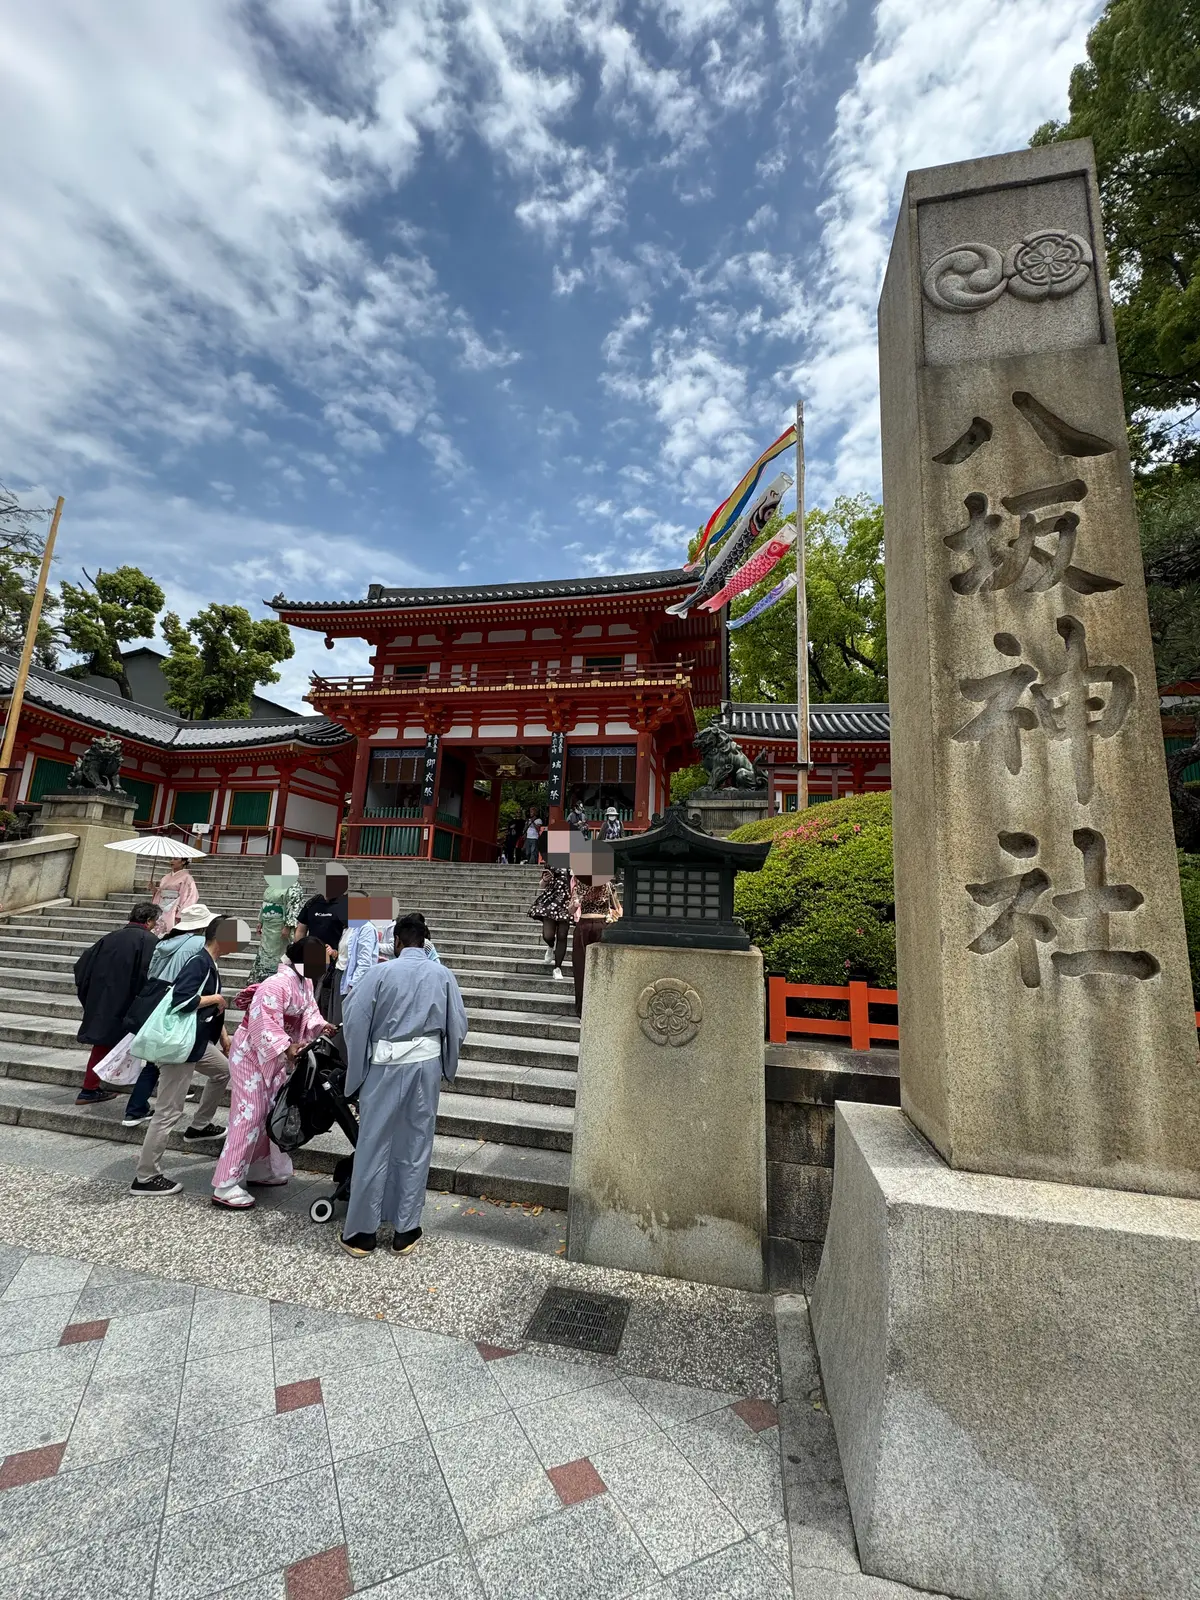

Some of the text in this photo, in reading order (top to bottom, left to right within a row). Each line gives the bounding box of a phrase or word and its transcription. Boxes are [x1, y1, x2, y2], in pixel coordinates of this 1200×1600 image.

[550, 760, 561, 800] 端午祭
[932, 391, 1161, 989] 八坂神社
